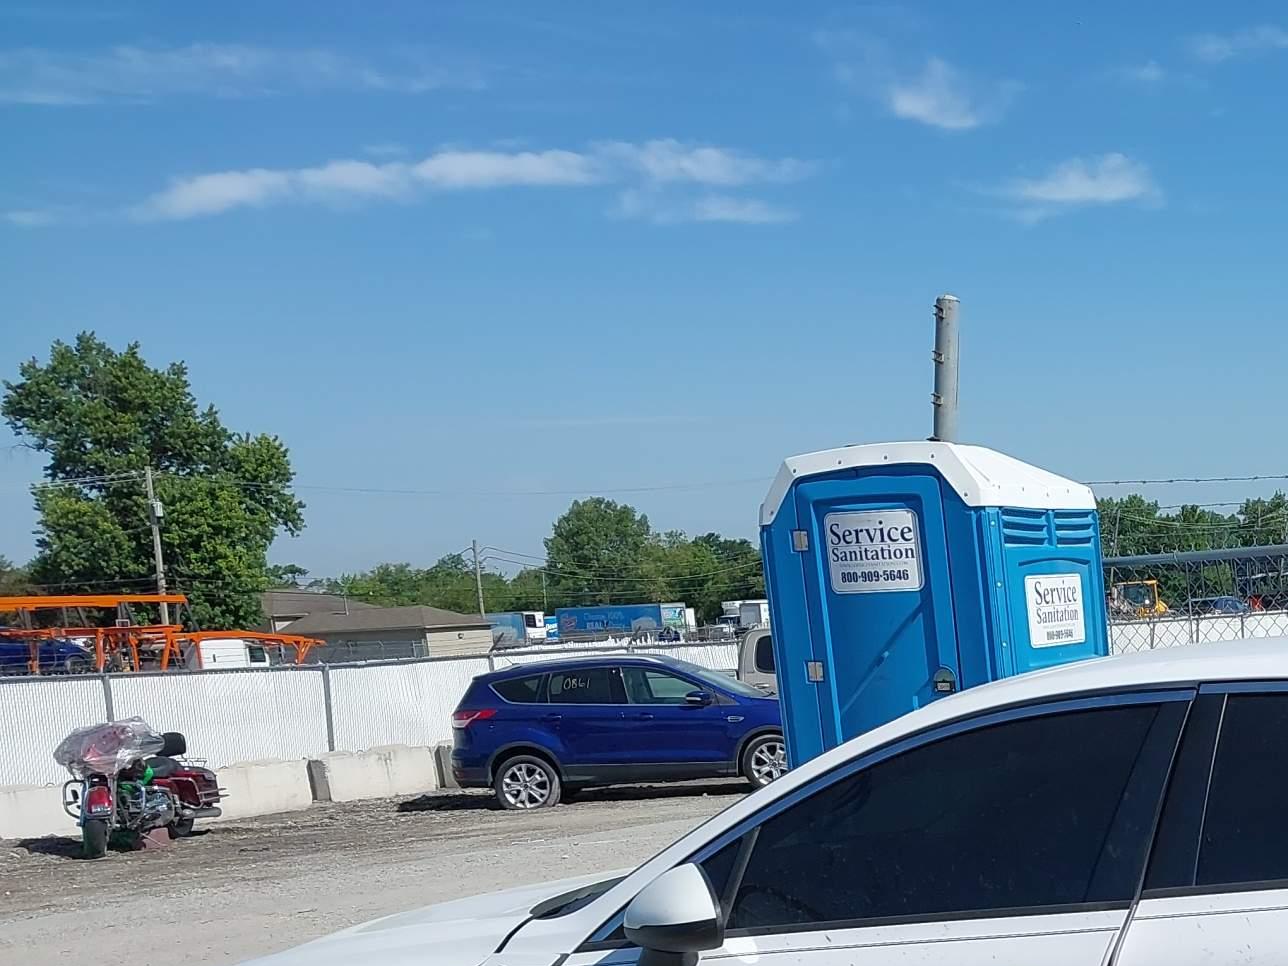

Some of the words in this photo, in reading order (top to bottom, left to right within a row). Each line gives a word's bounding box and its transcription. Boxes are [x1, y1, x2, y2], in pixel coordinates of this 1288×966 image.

[829, 520, 913, 545] Service
[831, 545, 916, 562] Sanitation
[1034, 579, 1078, 605] Service
[1036, 605, 1079, 624] Sanitation
[563, 677, 590, 690] 0861
